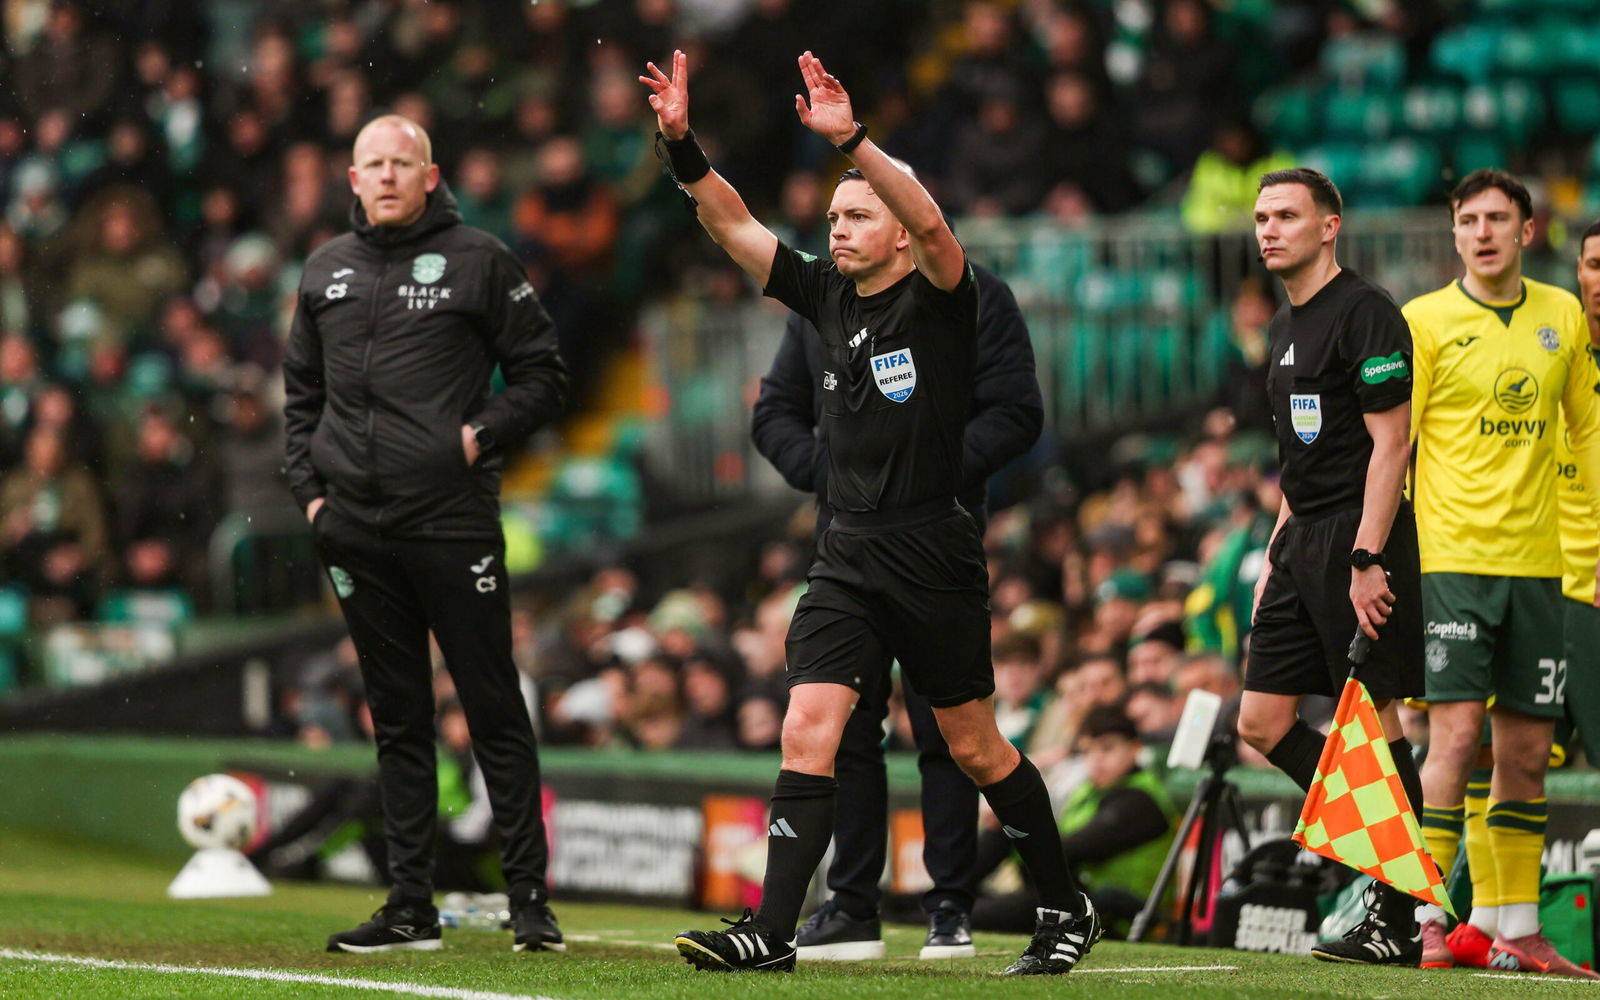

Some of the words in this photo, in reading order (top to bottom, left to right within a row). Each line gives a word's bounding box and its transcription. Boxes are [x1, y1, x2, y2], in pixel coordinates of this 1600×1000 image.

[398, 285, 452, 299] BLACK
[407, 298, 437, 310] IVY
[874, 352, 909, 371] FIFA
[879, 371, 914, 386] REFEREE
[892, 389, 908, 399] 2026
[1292, 398, 1317, 410] FIFA
[1480, 416, 1546, 440] bevvy
[1427, 621, 1468, 639] Capital
[1534, 658, 1567, 704] 32
